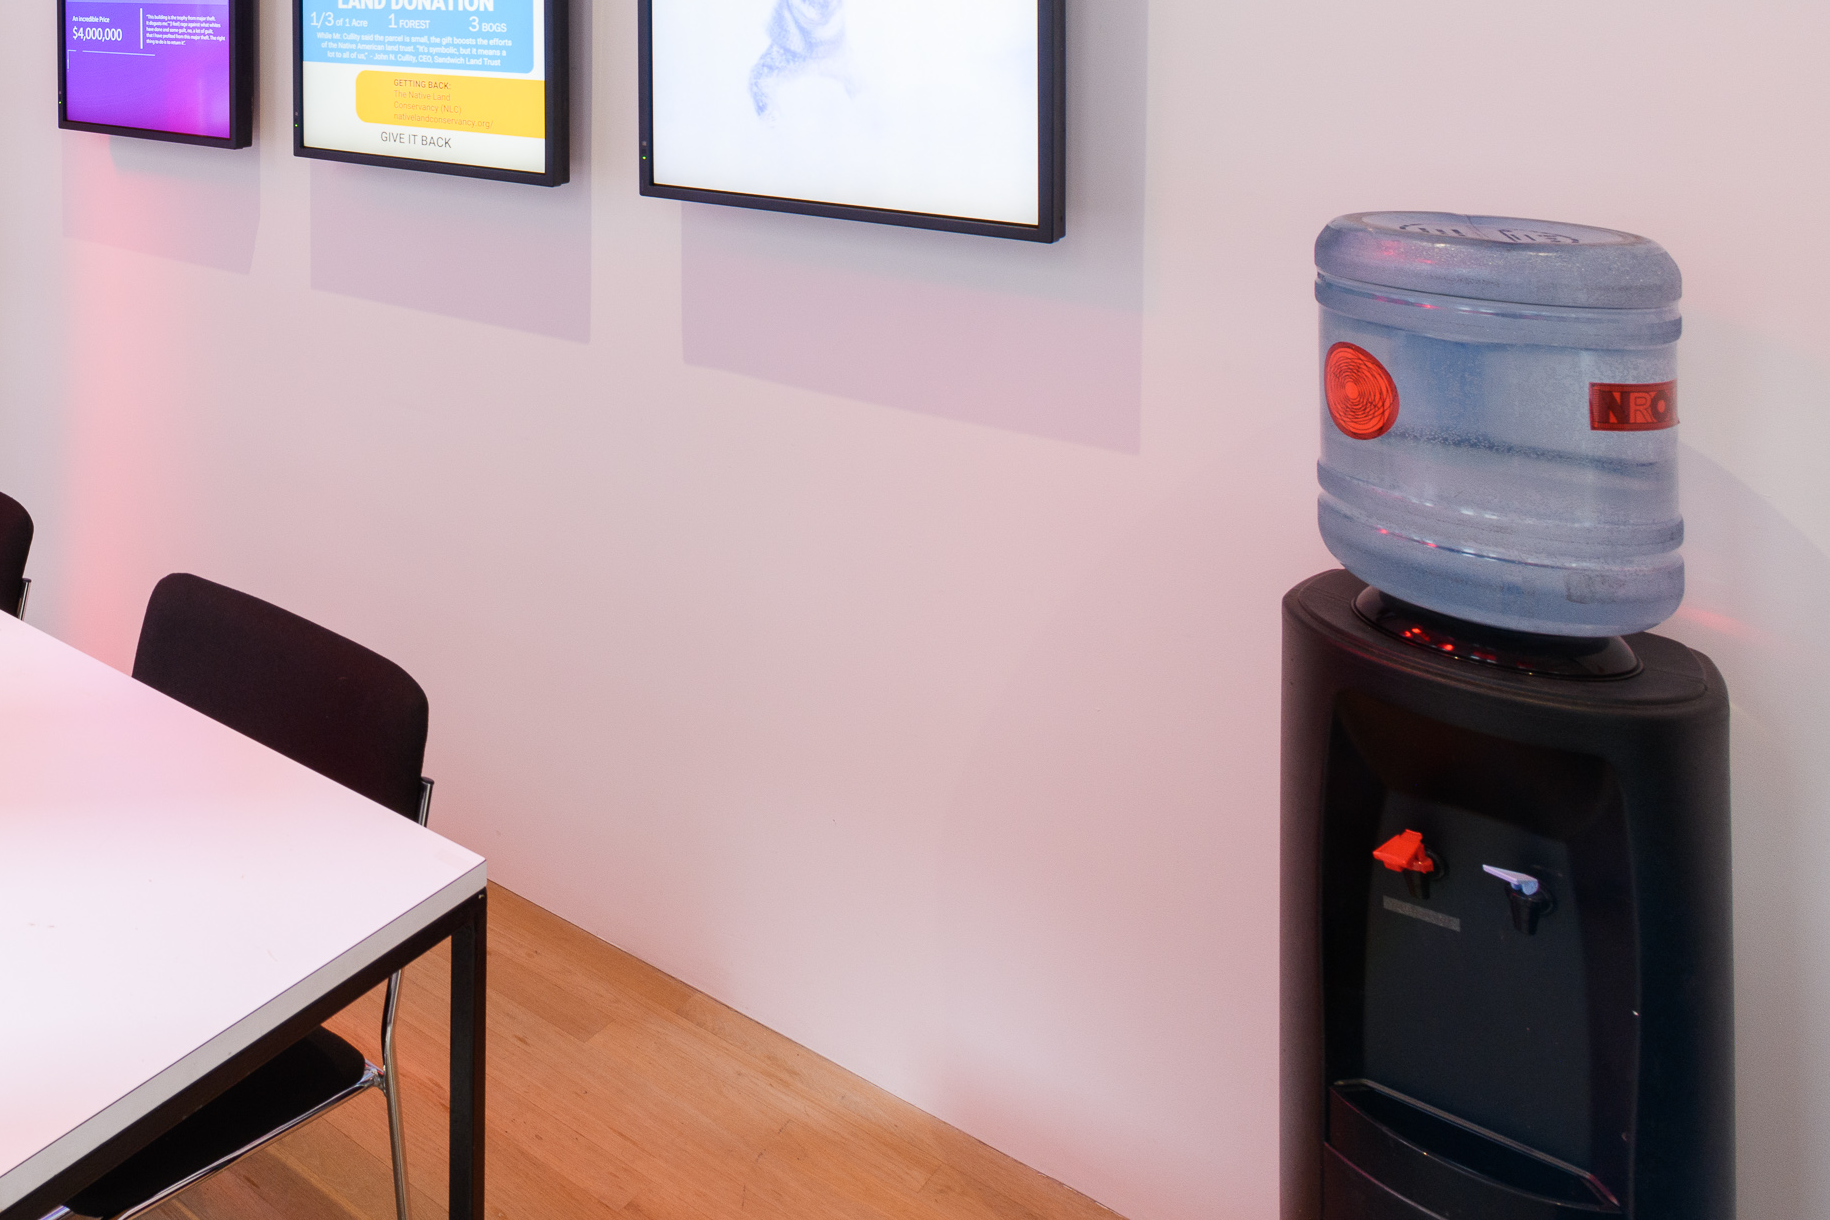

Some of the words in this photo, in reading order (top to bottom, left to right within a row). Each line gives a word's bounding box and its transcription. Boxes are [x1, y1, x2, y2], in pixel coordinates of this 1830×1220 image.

[310, 11, 334, 29] 1/3
[335, 18, 344, 26] of
[345, 18, 350, 27] 1
[351, 18, 368, 27] Acre
[388, 13, 398, 28] 1
[399, 19, 430, 29] FOREST
[468, 16, 480, 32] 3
[481, 23, 507, 33] BOGS
[72, 26, 123, 42] $4,000,000
[385, 35, 403, 43] parcel
[442, 36, 452, 45] gift
[454, 37, 476, 45] boosts
[477, 37, 488, 45] the
[489, 38, 512, 46] efforts
[328, 41, 337, 49] the
[357, 43, 385, 51] American
[459, 47, 470, 55] but
[351, 51, 357, 59] of
[373, 52, 389, 60] John
[434, 56, 465, 64] Sandwich
[465, 57, 482, 65] Land
[483, 58, 501, 66] Trust
[393, 78, 426, 89] GETTING
[428, 81, 451, 90] BACK:
[394, 90, 407, 98] The
[408, 91, 431, 100] Native
[433, 93, 451, 101] Land
[393, 101, 439, 113] Conservancy
[440, 105, 462, 115] (NLC)
[380, 131, 405, 144] GIVE
[408, 134, 418, 145] IT
[421, 135, 452, 148] BACK
